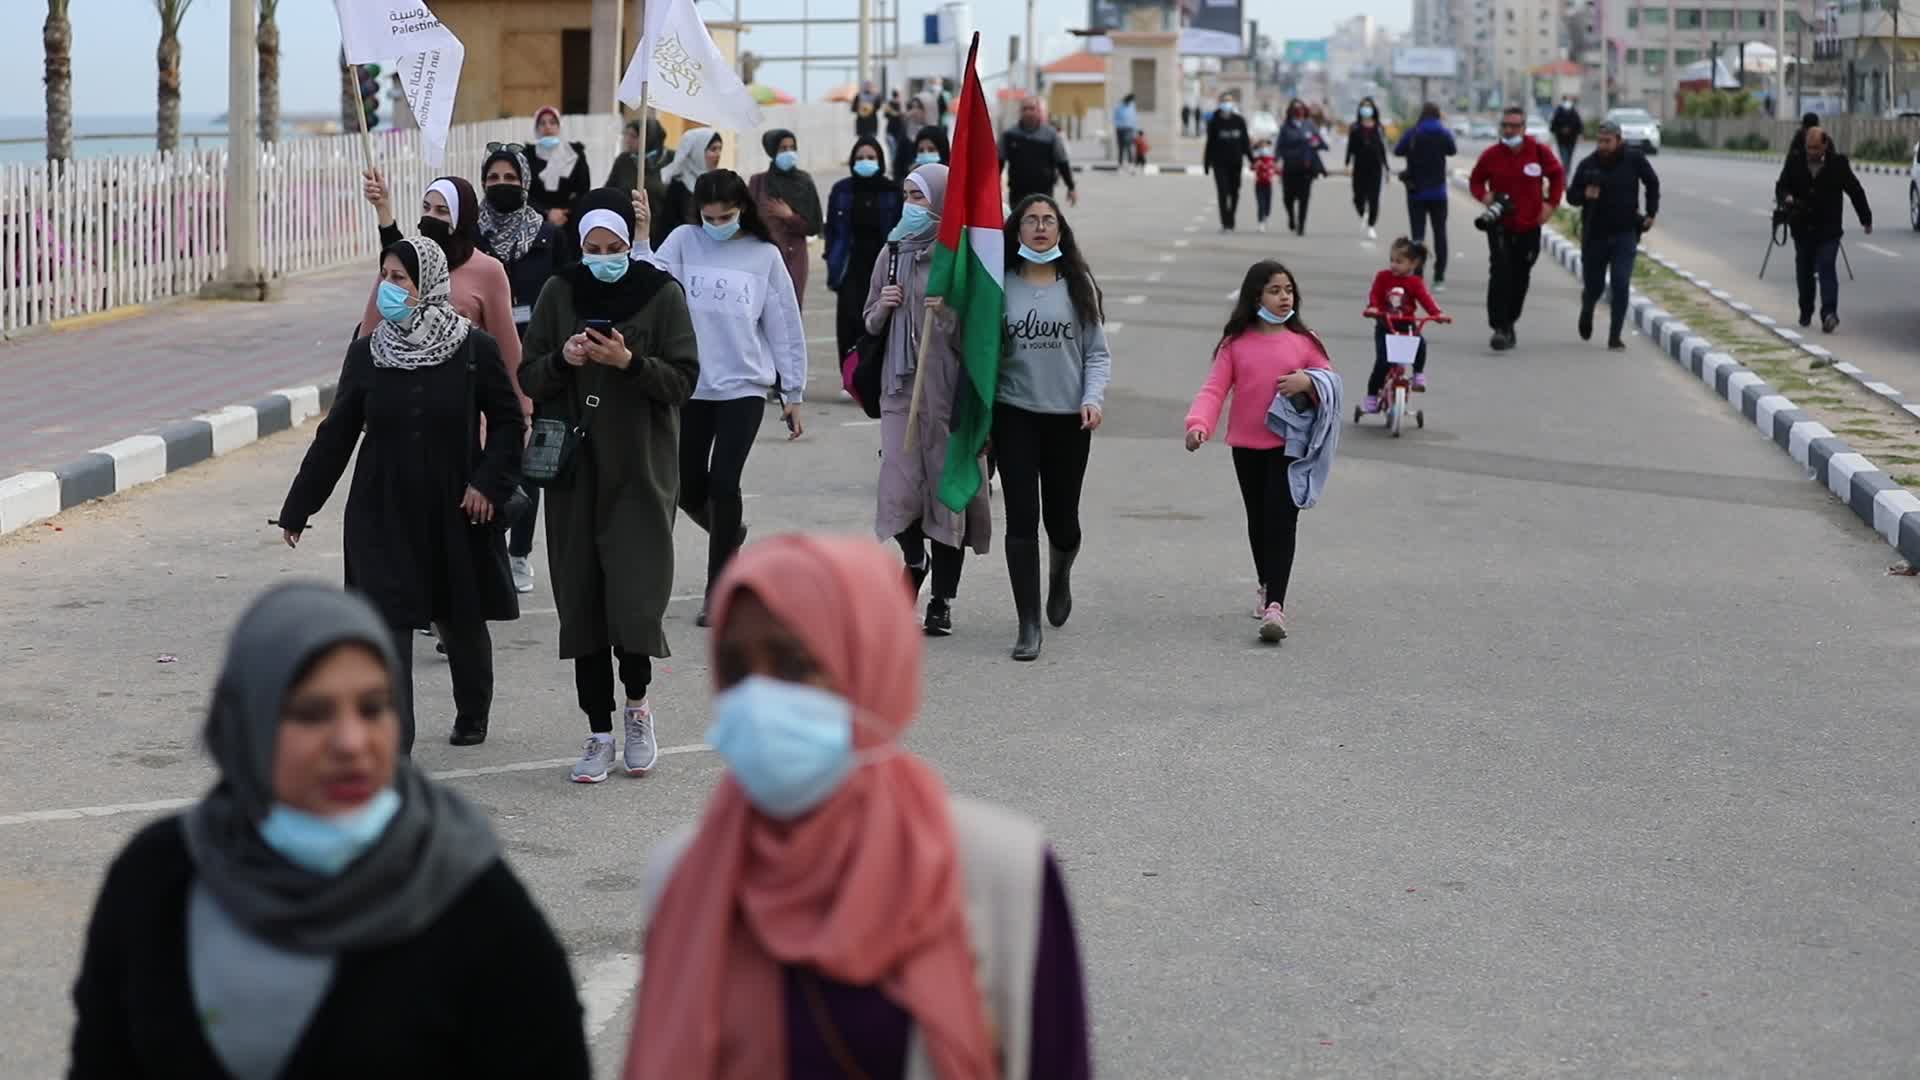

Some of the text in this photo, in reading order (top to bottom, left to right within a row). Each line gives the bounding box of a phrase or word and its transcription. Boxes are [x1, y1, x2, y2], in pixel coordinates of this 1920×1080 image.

[392, 20, 440, 35] Palestine
[1004, 308, 1075, 340] believe
[1030, 341, 1062, 349] YOURSELF
